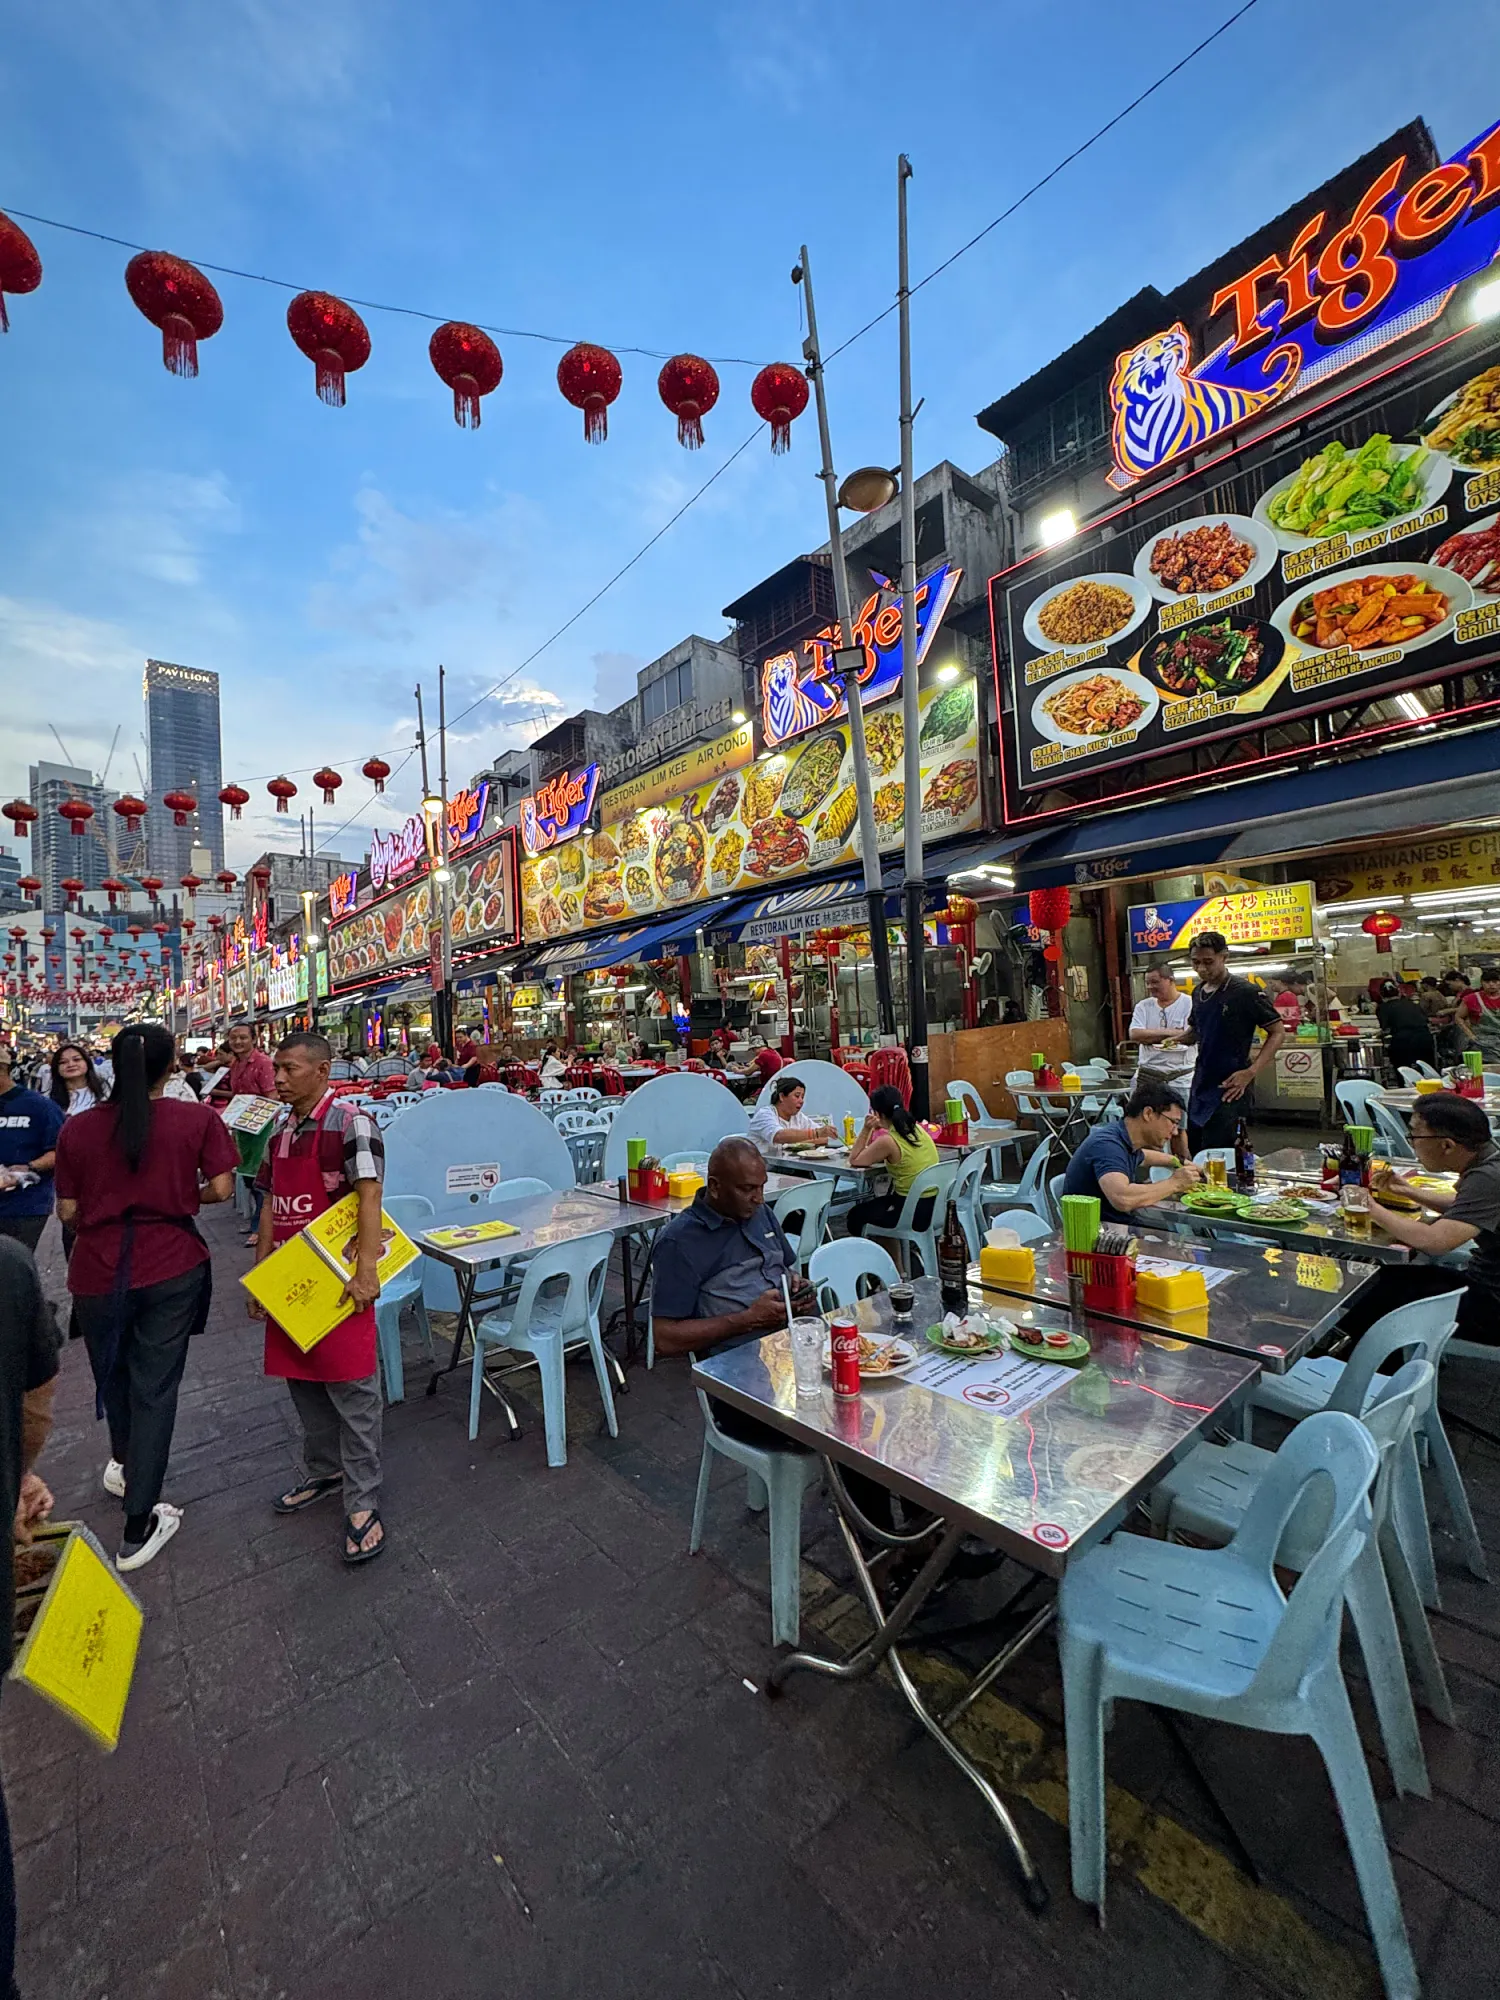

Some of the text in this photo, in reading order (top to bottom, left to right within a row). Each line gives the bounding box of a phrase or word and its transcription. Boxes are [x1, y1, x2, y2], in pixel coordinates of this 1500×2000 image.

[1284, 508, 1445, 581] WOK FRIED BABY KAILAN
[1161, 585, 1253, 630] MARMITE CHICKEN
[1062, 653, 1085, 671] FRIED
[1087, 643, 1106, 662] RICE
[1294, 654, 1359, 681] SWEET & SOUR
[1294, 651, 1401, 689] VEGETARIAN BEANCURD
[158, 666, 210, 683] PAVILION
[1165, 698, 1236, 729] SIZZLING BEEF
[600, 733, 664, 782] RESTORAN
[668, 717, 698, 748] LIM
[701, 700, 730, 729] KEE
[1033, 730, 1137, 769] PENANG CHAR KUEY TEOW
[604, 731, 748, 808] RESTORAN LIM KEE AIR COND
[446, 788, 480, 833] Tiger
[537, 771, 587, 826] Tiger
[1091, 857, 1131, 877] Tiger
[1353, 841, 1462, 872] HAINANESE
[1218, 893, 1258, 913] 大炒
[1263, 896, 1298, 908] FRIED
[1266, 888, 1293, 899] STIR
[750, 914, 820, 937] RESTORAN LIM KEE
[1246, 910, 1263, 919] PENANG
[1264, 908, 1278, 917] FRIED
[1134, 928, 1172, 948] Tiger
